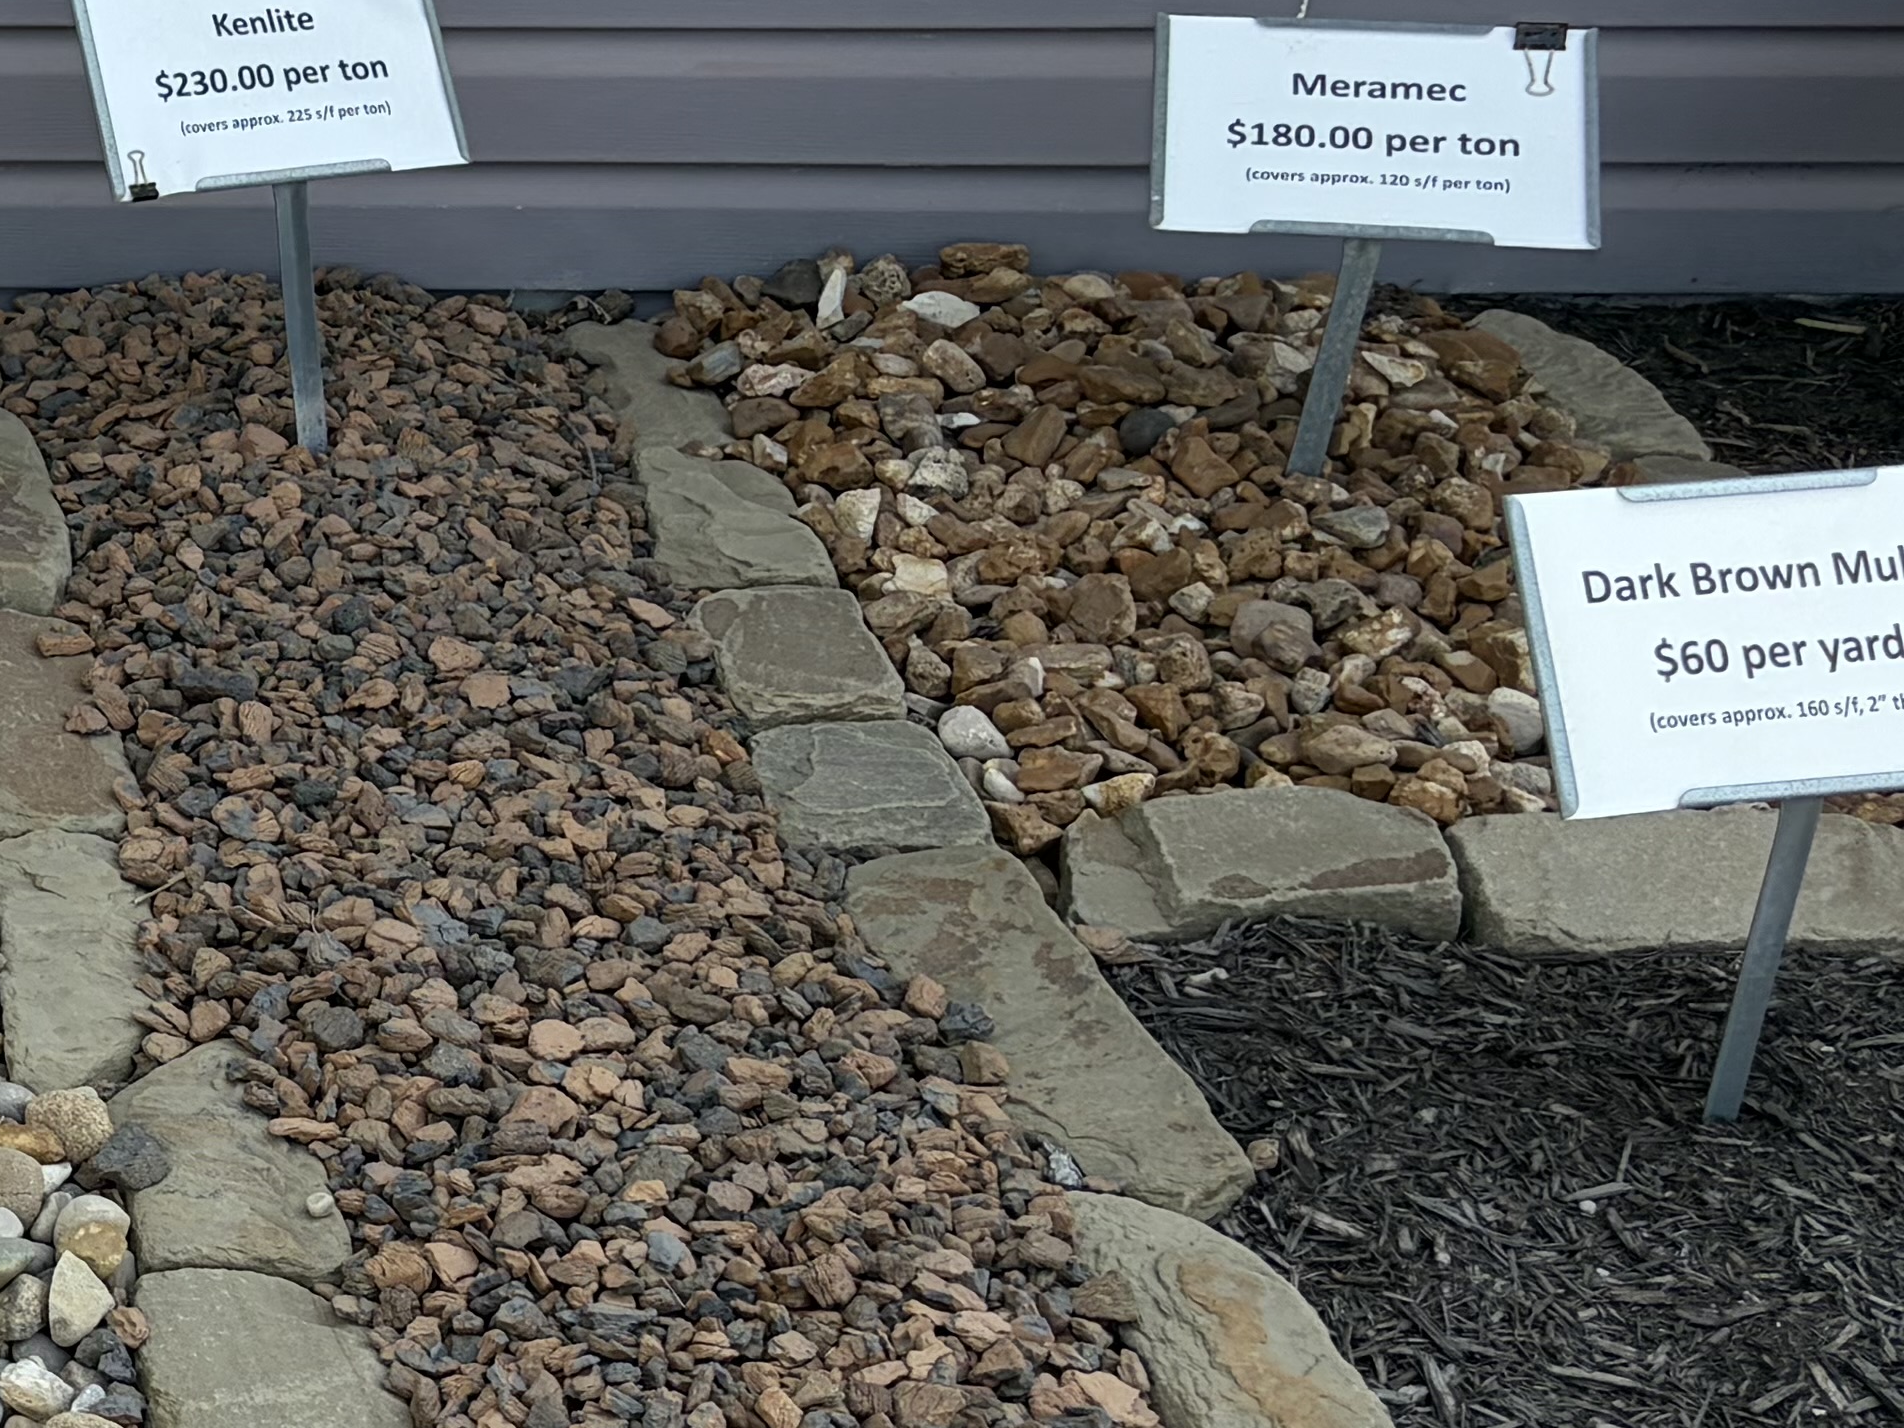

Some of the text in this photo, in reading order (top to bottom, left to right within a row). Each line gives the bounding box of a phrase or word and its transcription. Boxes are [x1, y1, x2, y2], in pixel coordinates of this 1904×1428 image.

[211, 8, 315, 37] Kenlite
[155, 59, 389, 103] $230.00 per ton
[1292, 72, 1467, 102] Meramec
[180, 100, 392, 137] (covers approx. 225 s/f per ton)
[1226, 118, 1520, 157] $180.00 per ton
[1245, 167, 1511, 194] (covers approx. 120 s/f per ton)
[1581, 562, 1681, 604] Dark
[1689, 561, 1821, 596] Brown
[1654, 622, 1904, 683] $60 per yard
[1649, 712, 1717, 734] (covers
[1721, 706, 1792, 727] approx.
[1796, 699, 1830, 718] 160
[1833, 696, 1864, 718] s/f,
